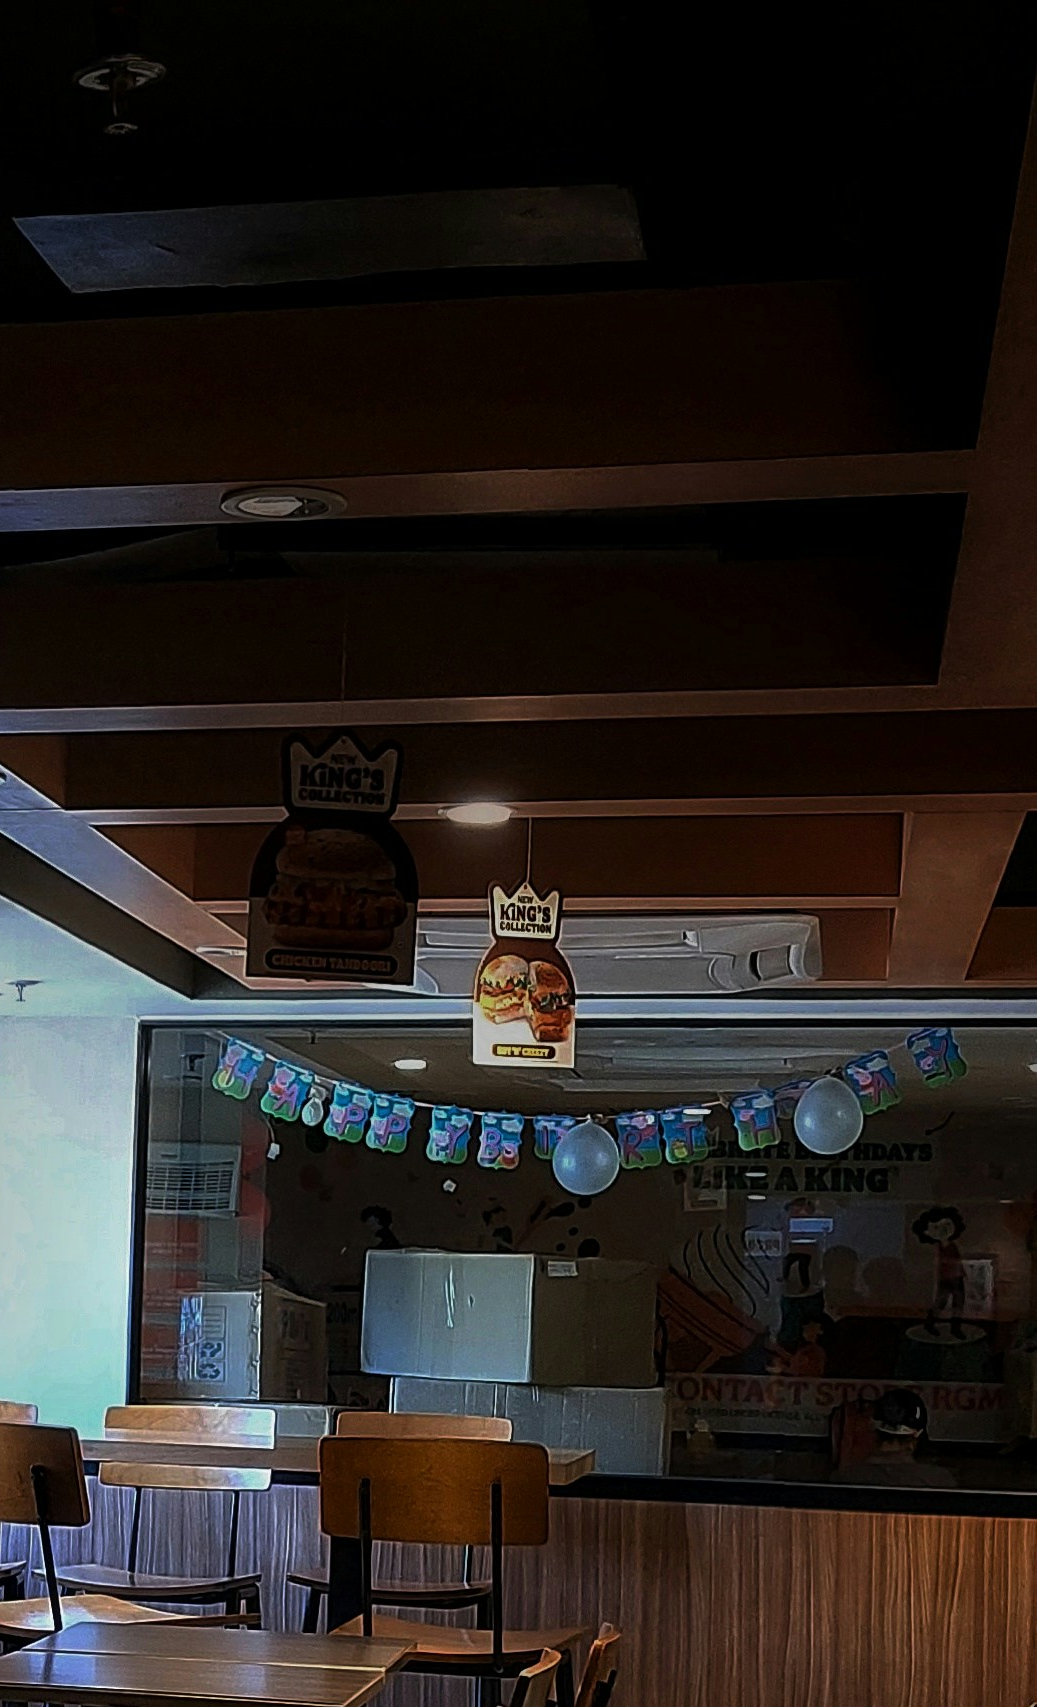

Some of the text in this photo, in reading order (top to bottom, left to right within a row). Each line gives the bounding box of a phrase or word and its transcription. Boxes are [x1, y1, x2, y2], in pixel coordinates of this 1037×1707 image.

[298, 787, 386, 805] COLLECTION
[517, 895, 534, 904] NEW
[499, 921, 552, 934] COLLECTION
[774, 1166, 798, 1191] A
[805, 1166, 889, 1192] KING
[664, 1374, 810, 1406] ONTACT
